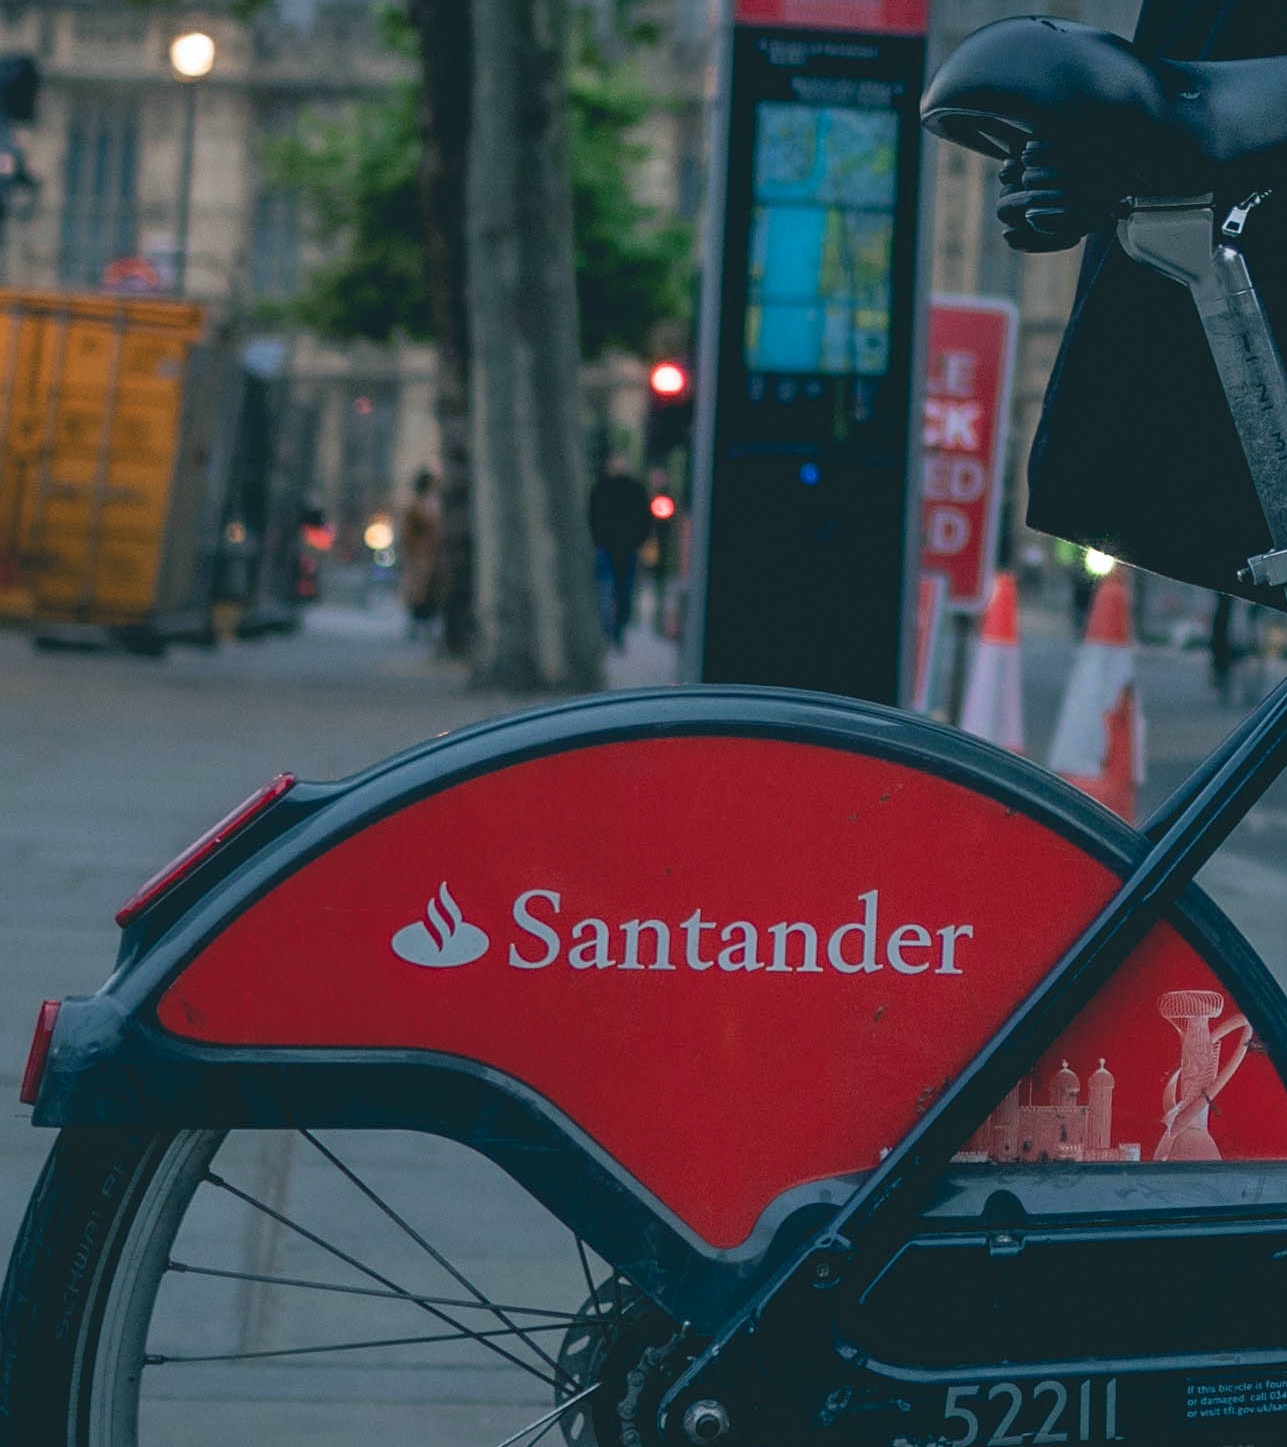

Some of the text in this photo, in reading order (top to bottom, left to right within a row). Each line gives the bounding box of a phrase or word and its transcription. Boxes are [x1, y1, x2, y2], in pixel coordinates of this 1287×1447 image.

[506, 888, 974, 976] Santander
[1197, 1383, 1216, 1394] this
[1218, 1381, 1253, 1393] bicycle
[1187, 1398, 1198, 1406] or
[1250, 1392, 1267, 1402] call
[1187, 1410, 1198, 1418] or
[1200, 1406, 1221, 1417] visit
